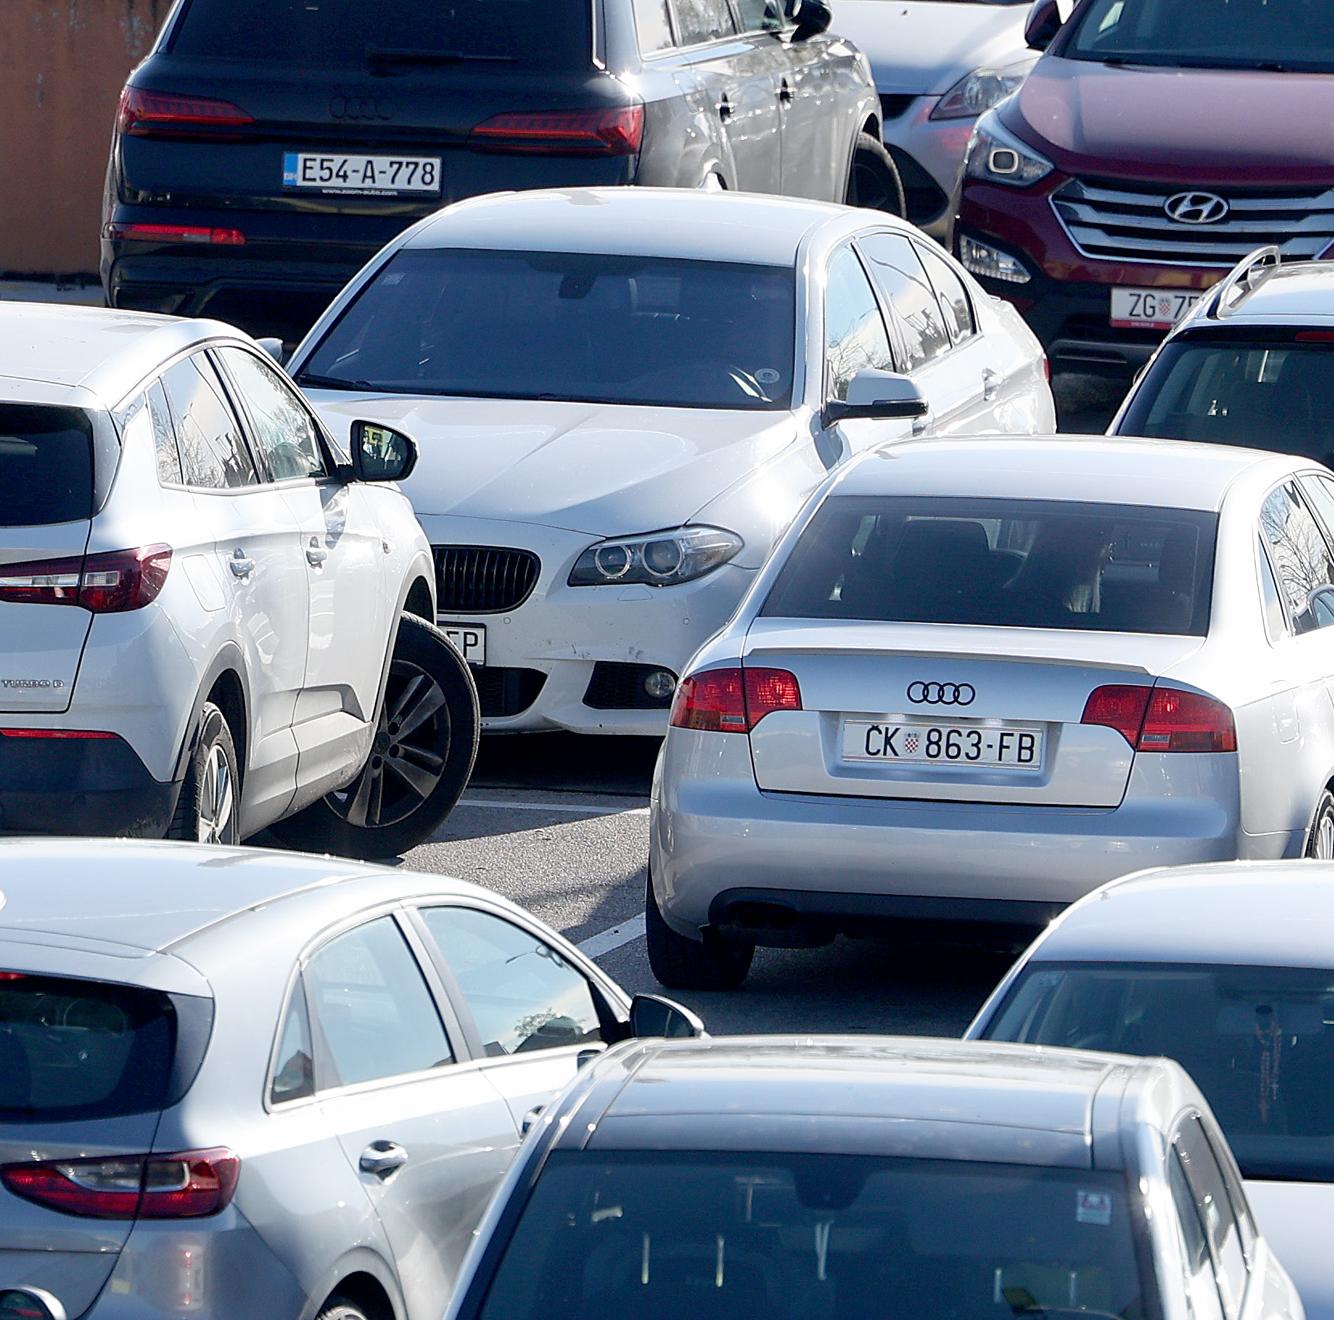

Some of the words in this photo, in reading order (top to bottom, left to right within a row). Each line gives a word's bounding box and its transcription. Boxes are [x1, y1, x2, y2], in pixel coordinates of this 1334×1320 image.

[301, 157, 435, 186] E54-A-778
[1129, 293, 1156, 318] ZG
[1, 679, 50, 688] TURBO
[53, 679, 64, 688] D
[865, 724, 901, 757] ČK
[925, 727, 1035, 764] 863-FB
